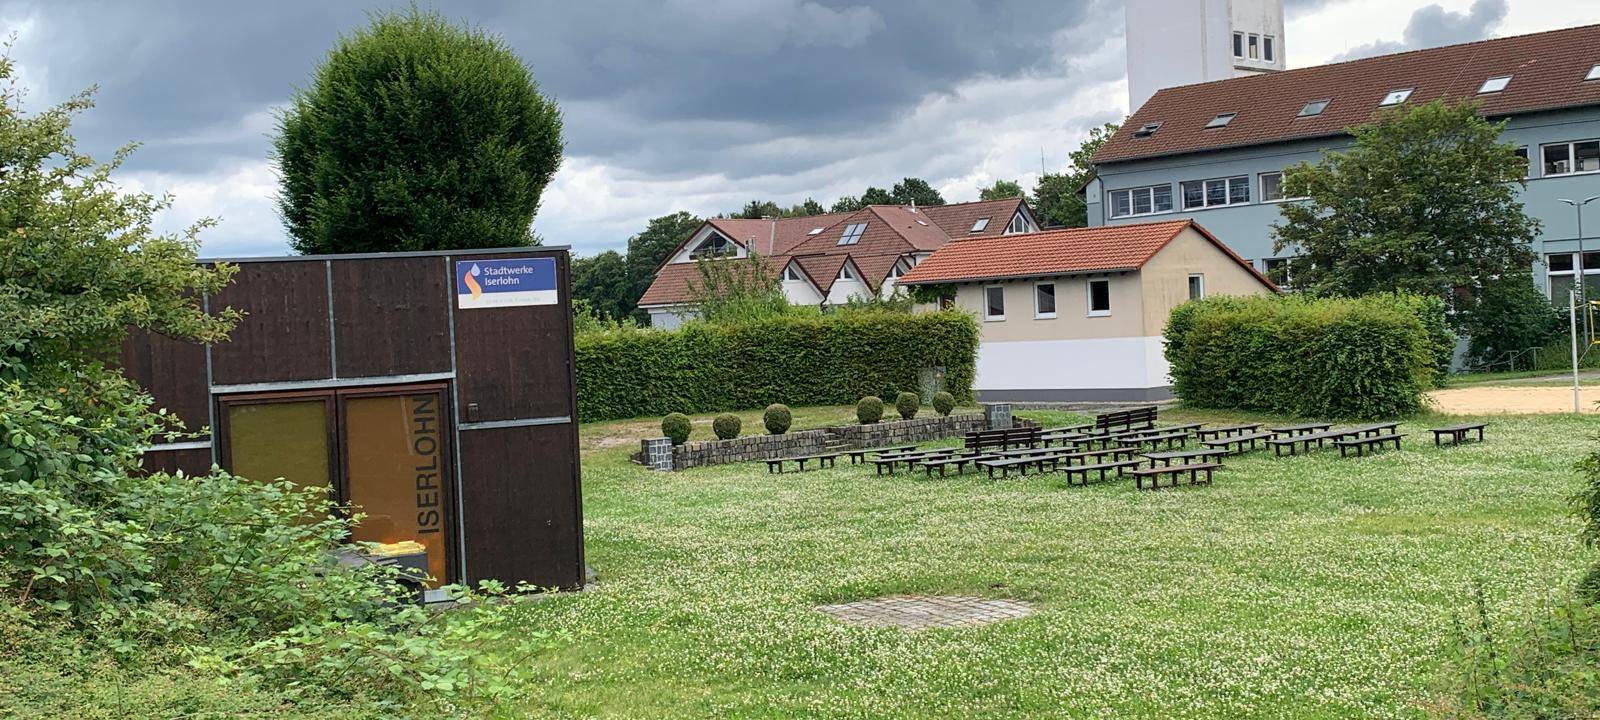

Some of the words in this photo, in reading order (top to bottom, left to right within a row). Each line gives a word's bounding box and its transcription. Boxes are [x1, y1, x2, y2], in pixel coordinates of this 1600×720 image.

[484, 265, 534, 276] Stadtwerke
[484, 276, 520, 286] Iserlohn
[413, 394, 440, 534] ISERLOHN
